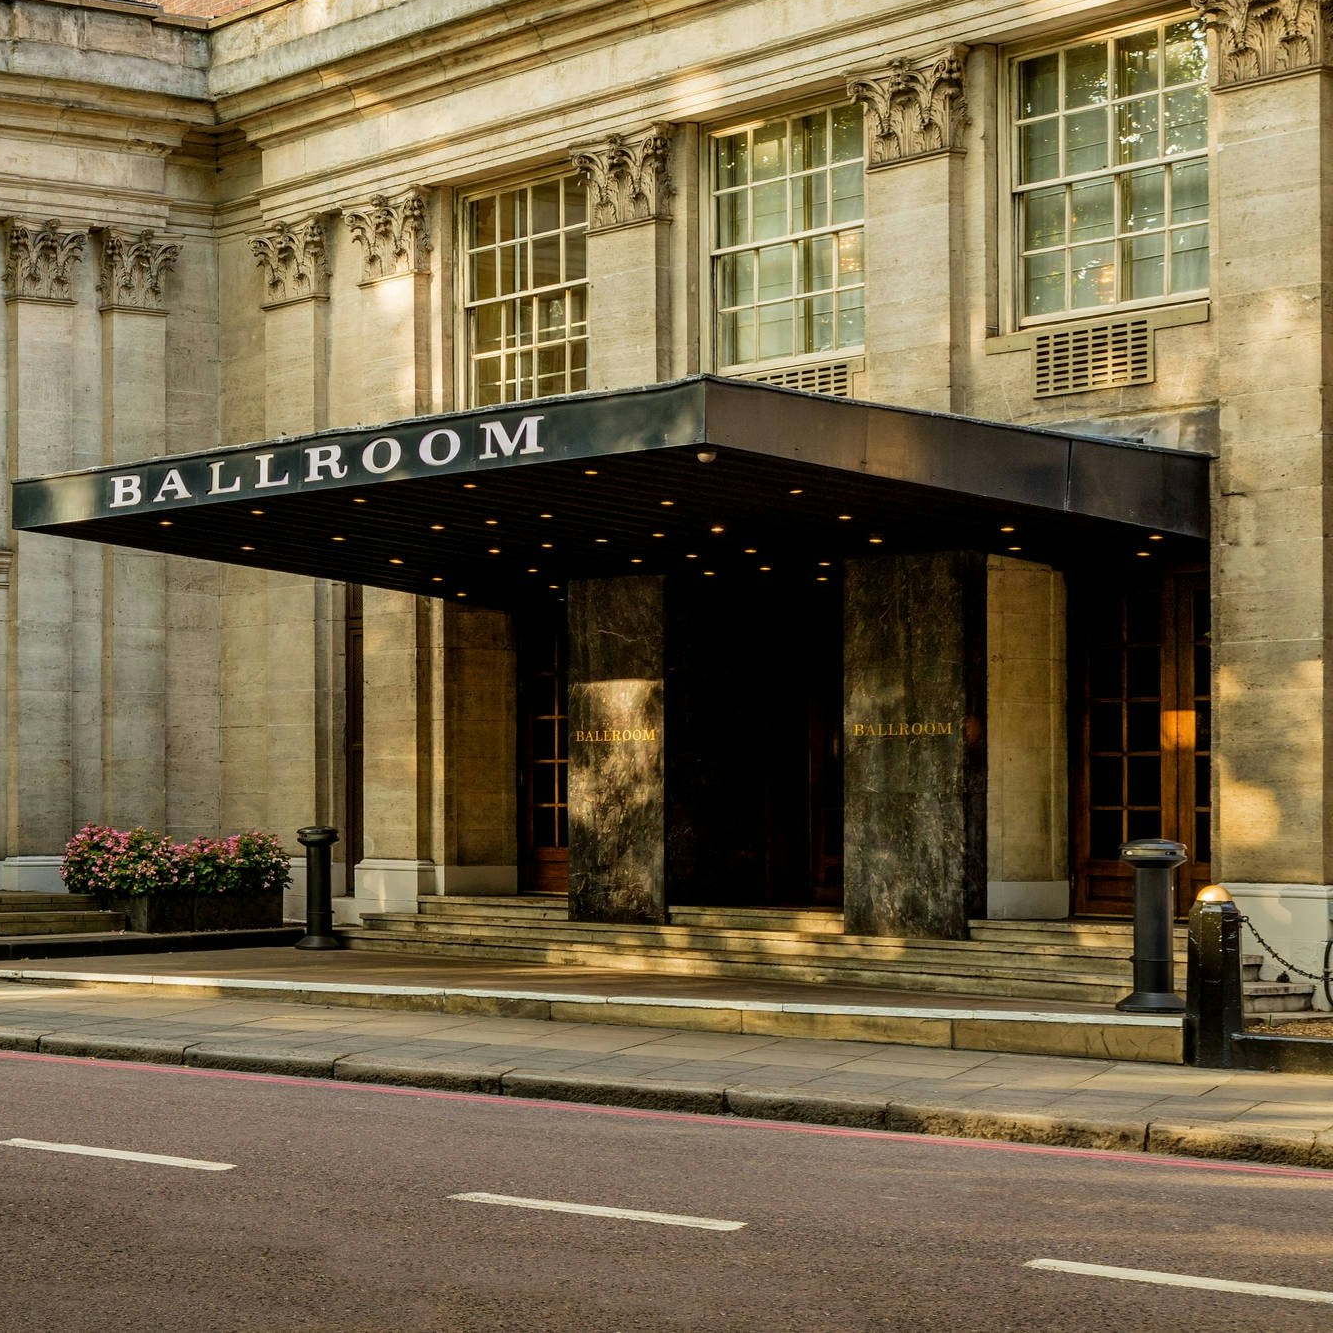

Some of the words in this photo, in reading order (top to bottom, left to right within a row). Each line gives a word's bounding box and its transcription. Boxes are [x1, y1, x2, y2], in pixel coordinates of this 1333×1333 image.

[109, 415, 545, 509] BALLROOM
[576, 729, 656, 742] BALLROOM
[853, 722, 953, 737] BALLROOM
